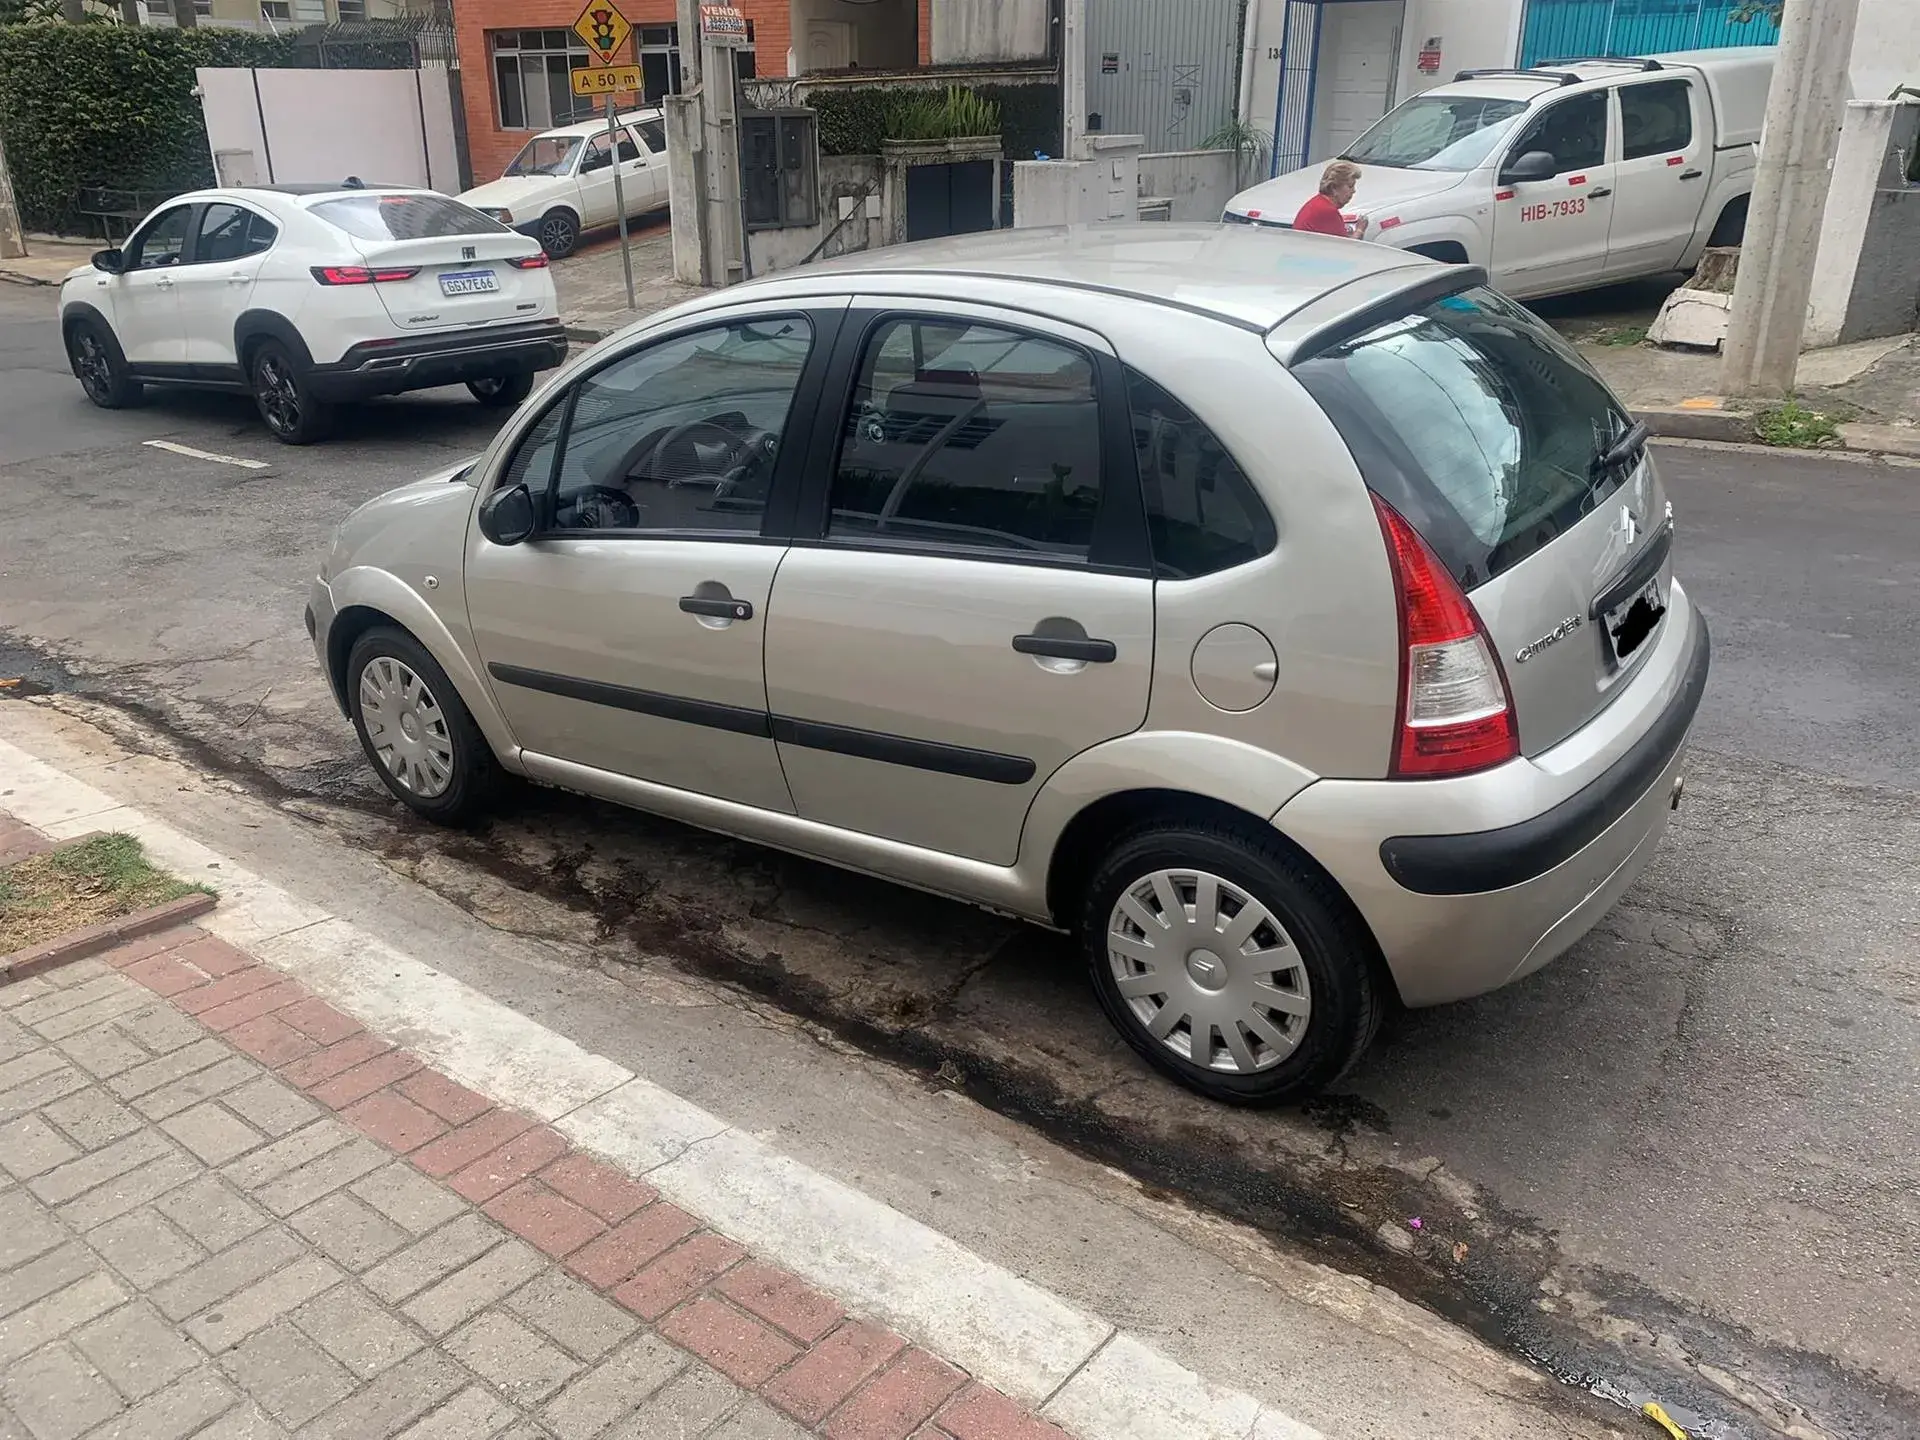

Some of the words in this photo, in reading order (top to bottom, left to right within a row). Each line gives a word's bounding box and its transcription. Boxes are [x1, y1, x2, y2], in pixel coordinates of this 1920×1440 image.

[702, 6, 741, 17] VENDE
[581, 76, 591, 88] A
[598, 73, 616, 86] 50
[624, 74, 636, 85] m
[1521, 198, 1585, 222] HIB-7933
[447, 278, 494, 292] GGX7E66
